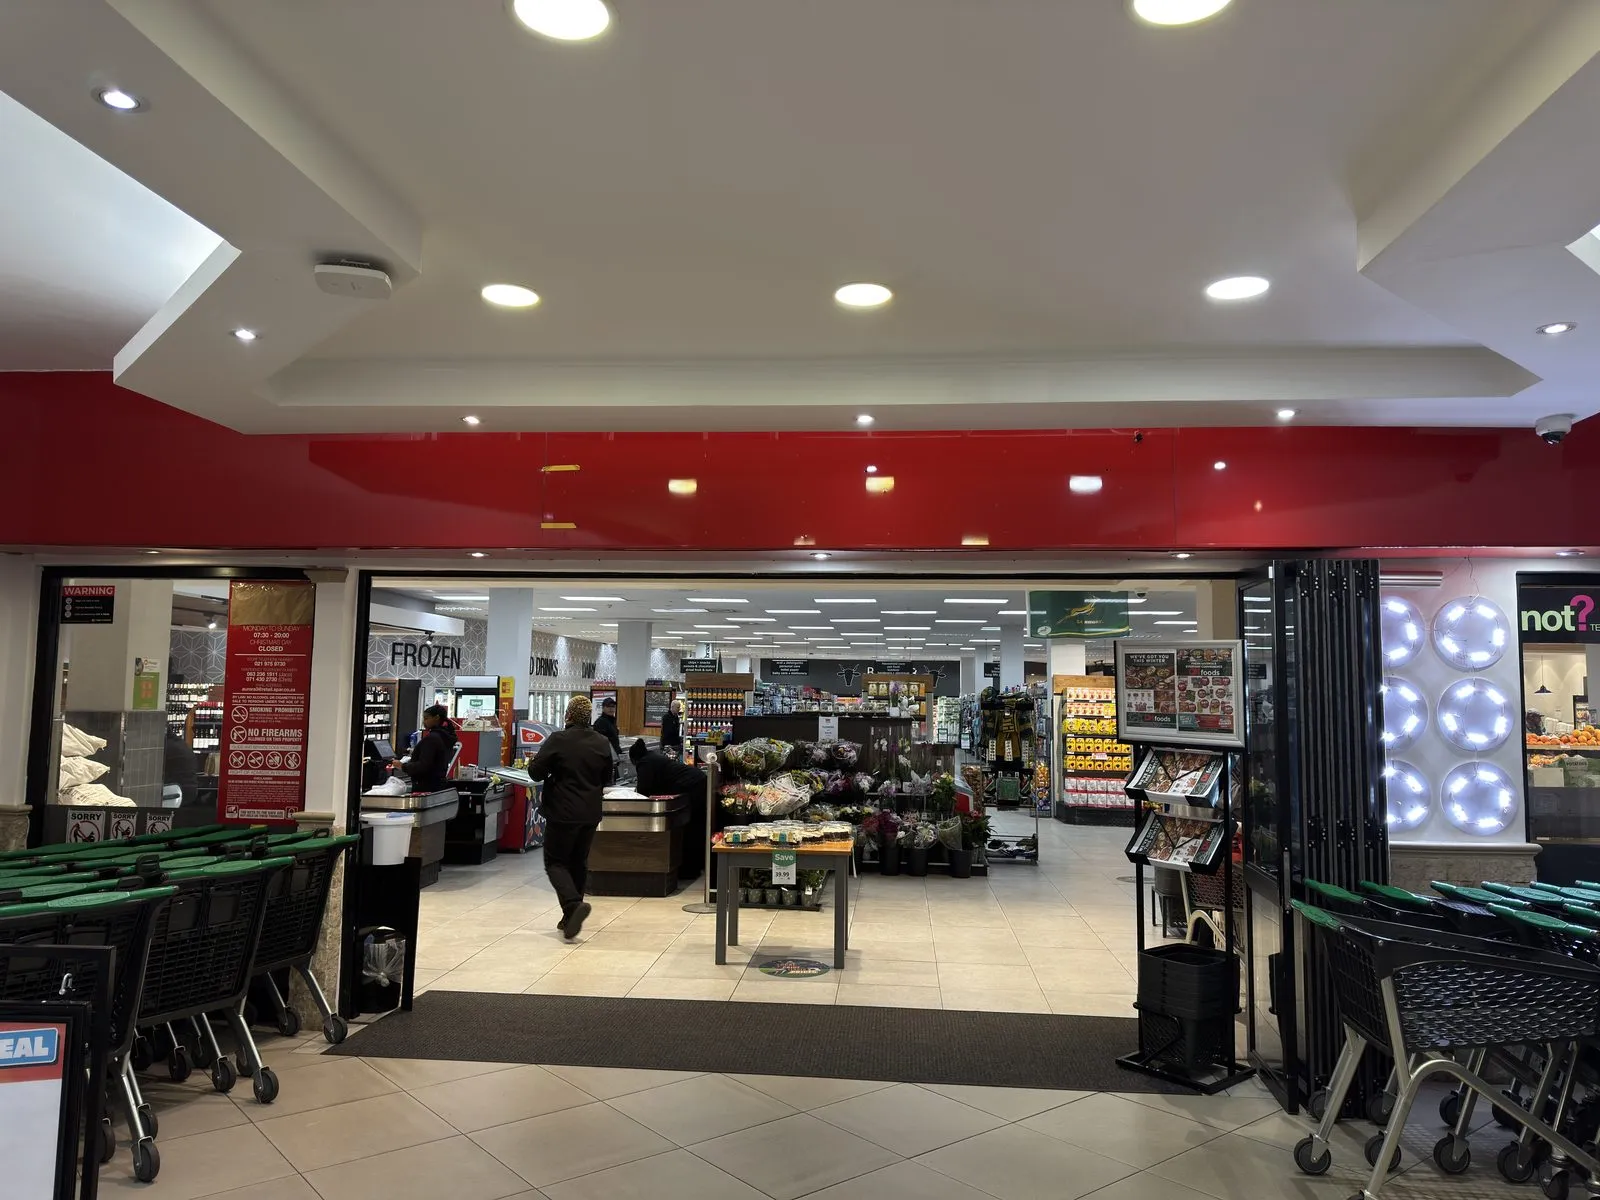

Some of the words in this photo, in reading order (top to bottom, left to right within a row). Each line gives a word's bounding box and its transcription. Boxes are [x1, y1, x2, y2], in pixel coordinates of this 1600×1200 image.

[64, 586, 114, 595] WARNING
[391, 642, 460, 669] FROZEN
[536, 657, 558, 677] DRINKS
[262, 729, 302, 737] FIREARMS
[0, 1036, 49, 1059] EAL
